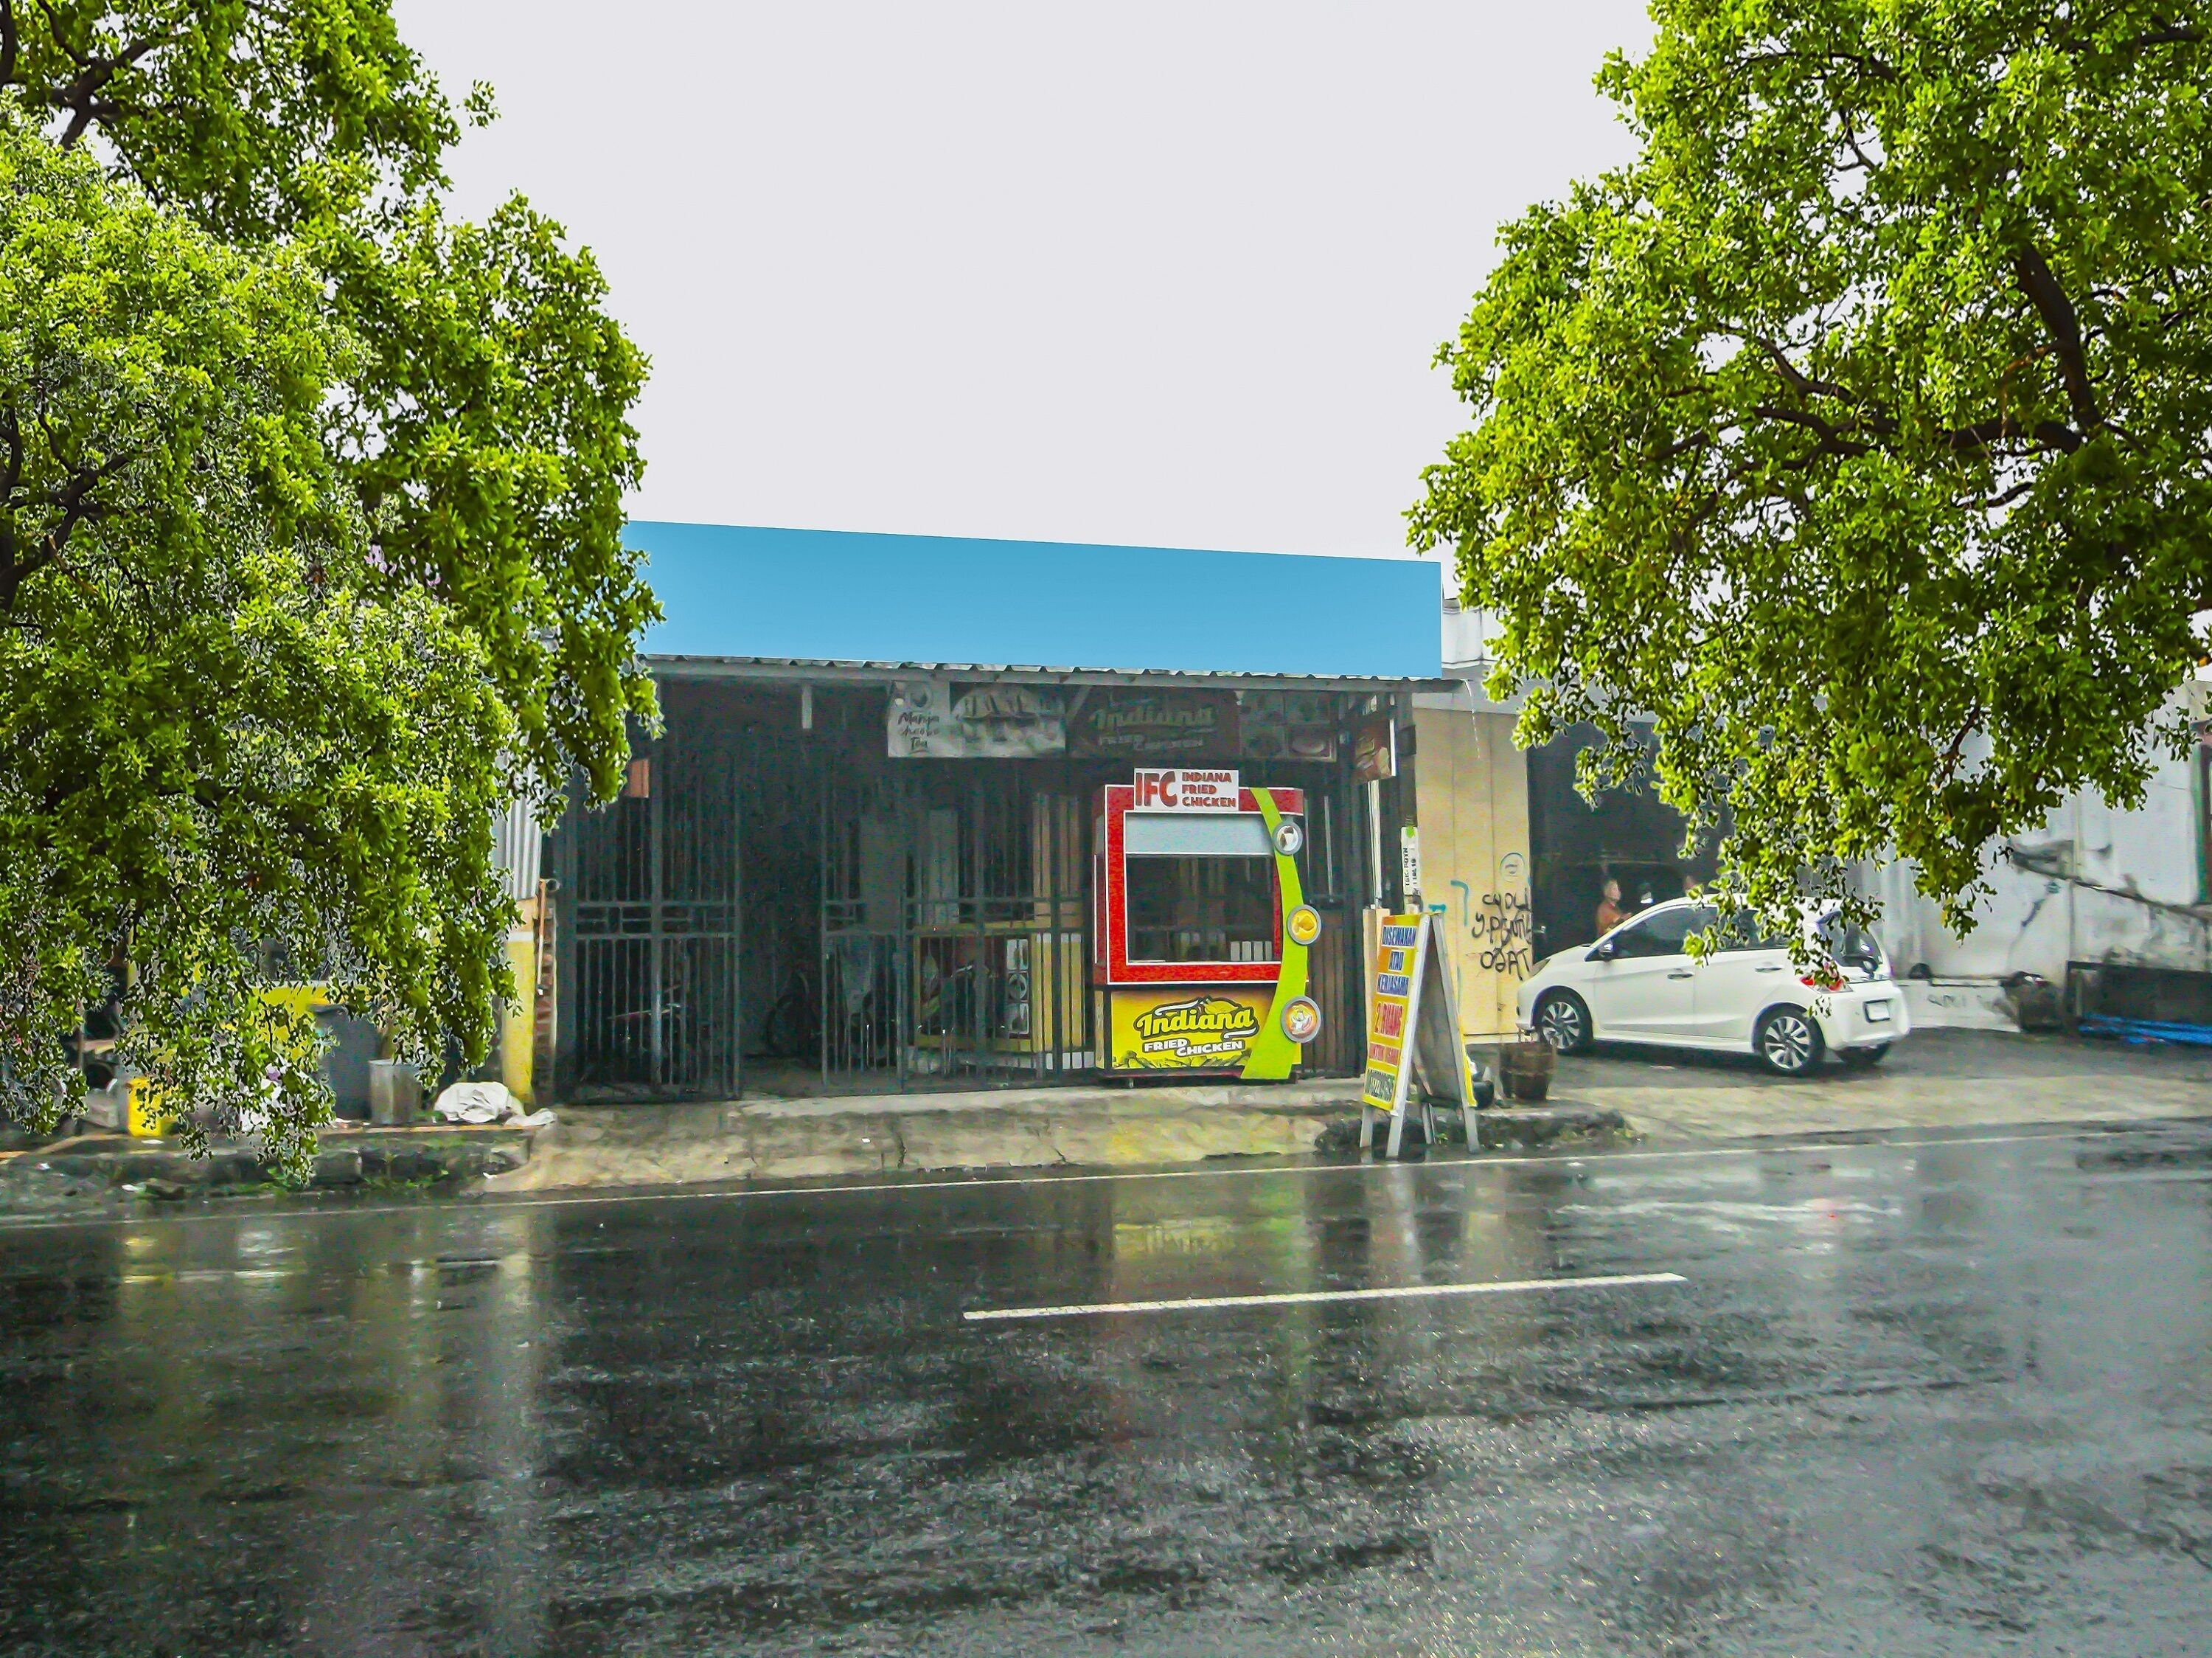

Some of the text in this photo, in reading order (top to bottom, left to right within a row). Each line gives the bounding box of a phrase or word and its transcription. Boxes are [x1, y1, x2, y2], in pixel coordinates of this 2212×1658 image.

[1182, 772, 1231, 783] INDIANA
[1135, 771, 1178, 807] IFC
[1182, 785, 1217, 794] FRIED
[1182, 797, 1236, 807] CHICKEN
[1137, 1009, 1254, 1037] Indiana
[1144, 1039, 1242, 1056] FRIED CHICKEN
